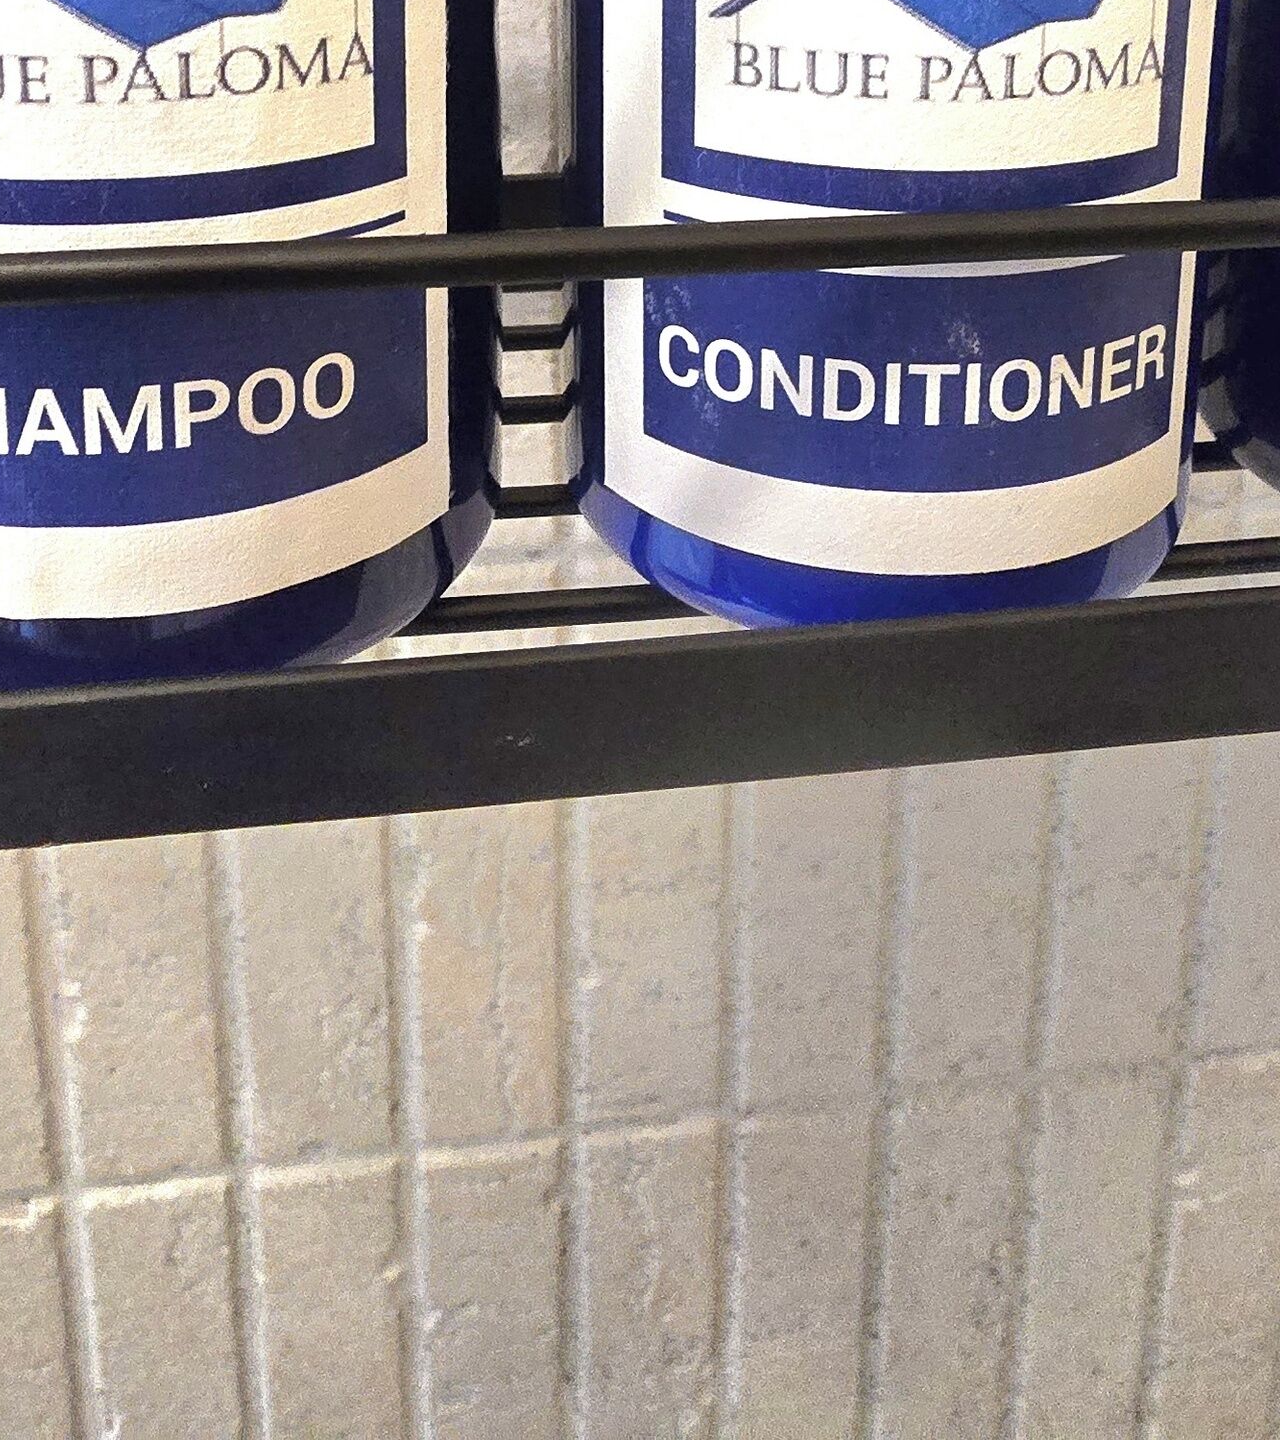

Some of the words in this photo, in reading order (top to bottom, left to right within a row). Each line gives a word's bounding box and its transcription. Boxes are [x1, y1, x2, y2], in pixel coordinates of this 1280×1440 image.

[82, 34, 375, 105] PALOMA
[730, 41, 890, 101] BLUE
[911, 40, 1165, 103] PALOMA
[658, 324, 1167, 426] CONDITIONER
